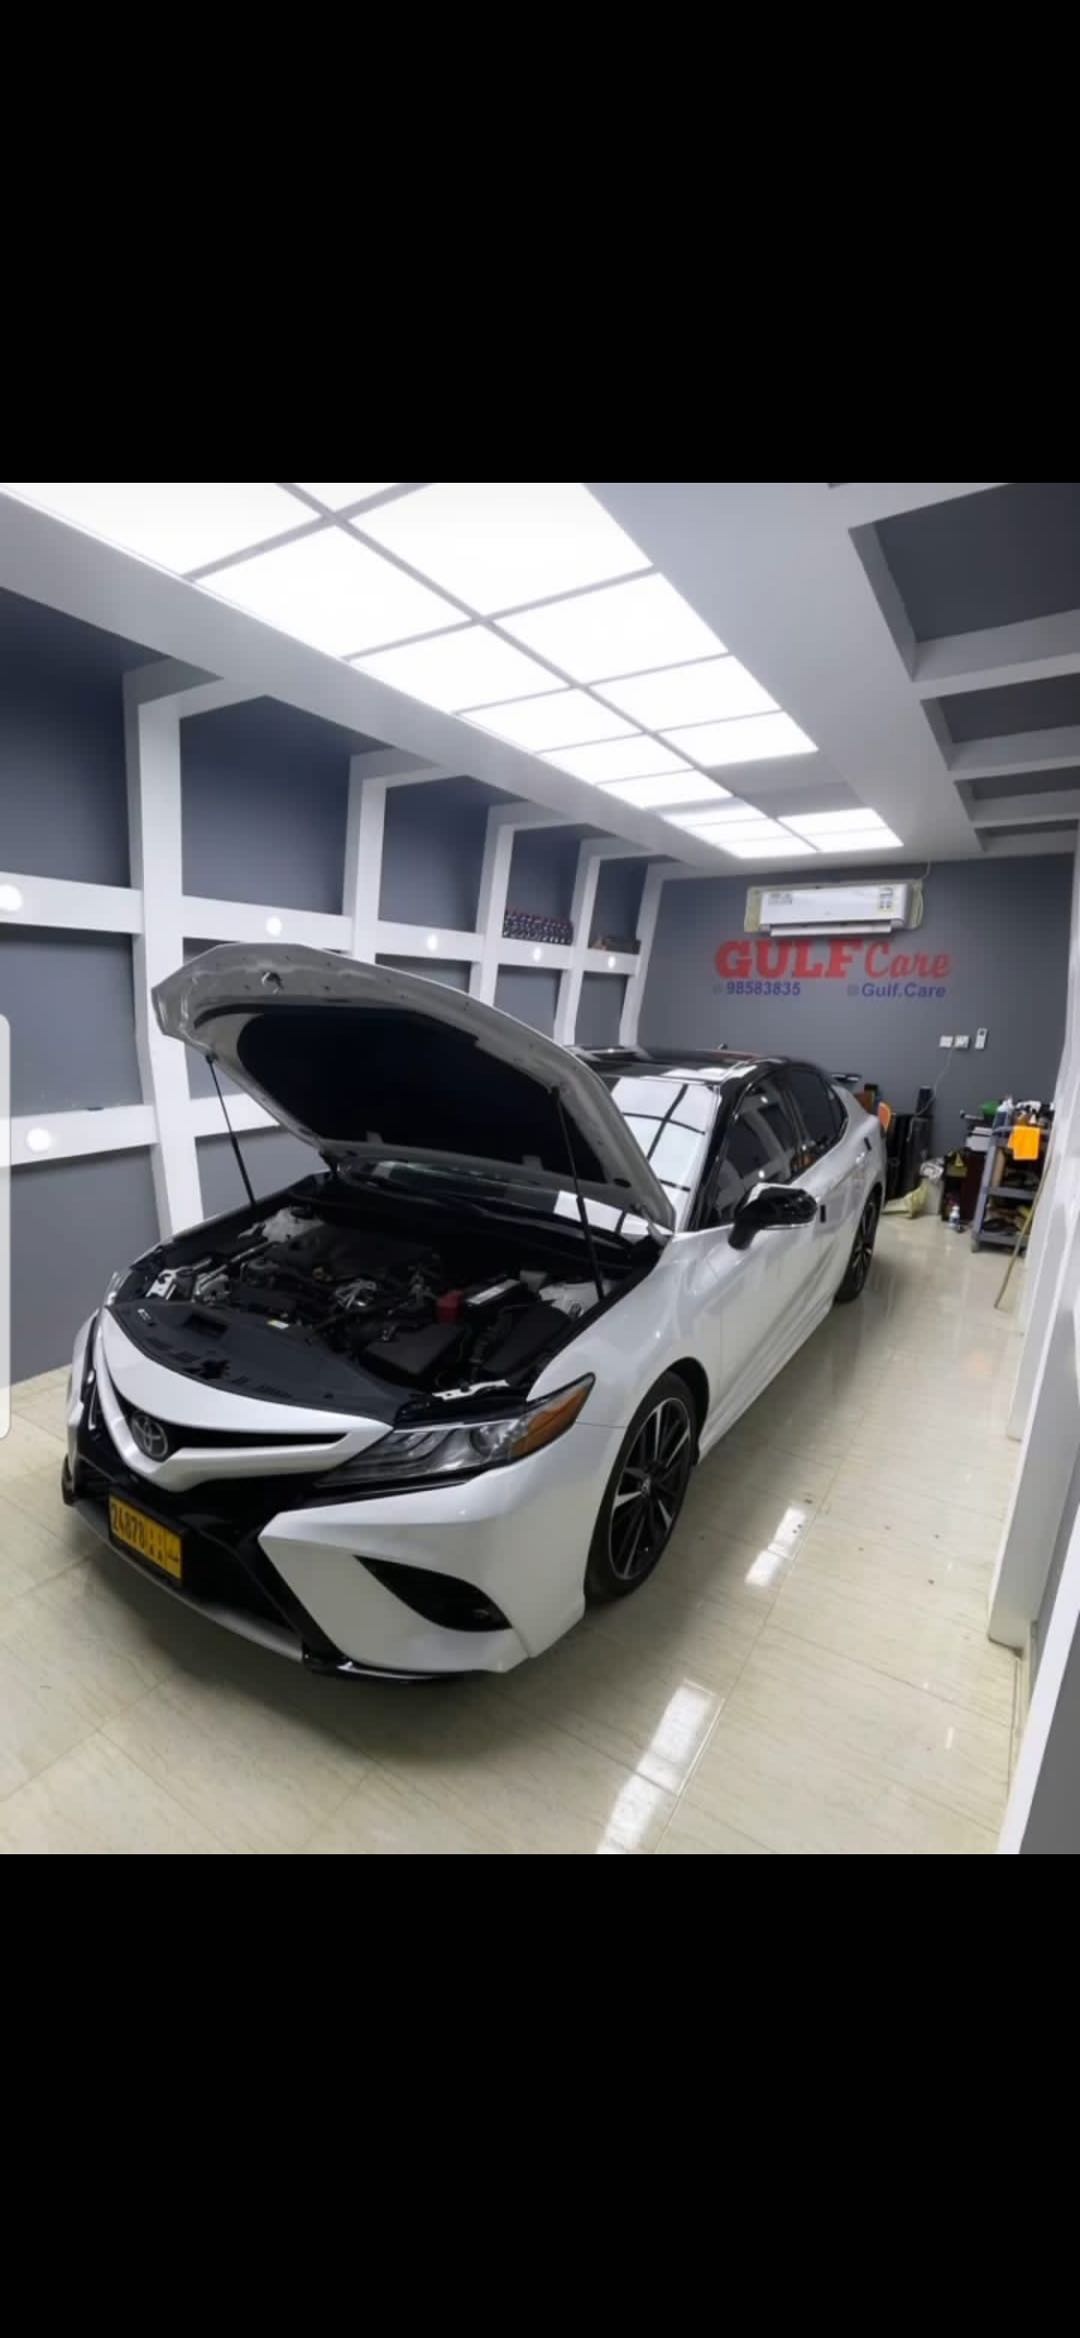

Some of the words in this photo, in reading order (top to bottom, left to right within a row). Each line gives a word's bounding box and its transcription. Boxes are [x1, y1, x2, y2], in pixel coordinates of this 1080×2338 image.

[715, 939, 864, 979] GULF
[864, 939, 952, 979] Care
[726, 981, 801, 996] 98583835
[861, 982, 946, 998] Gulf.Care
